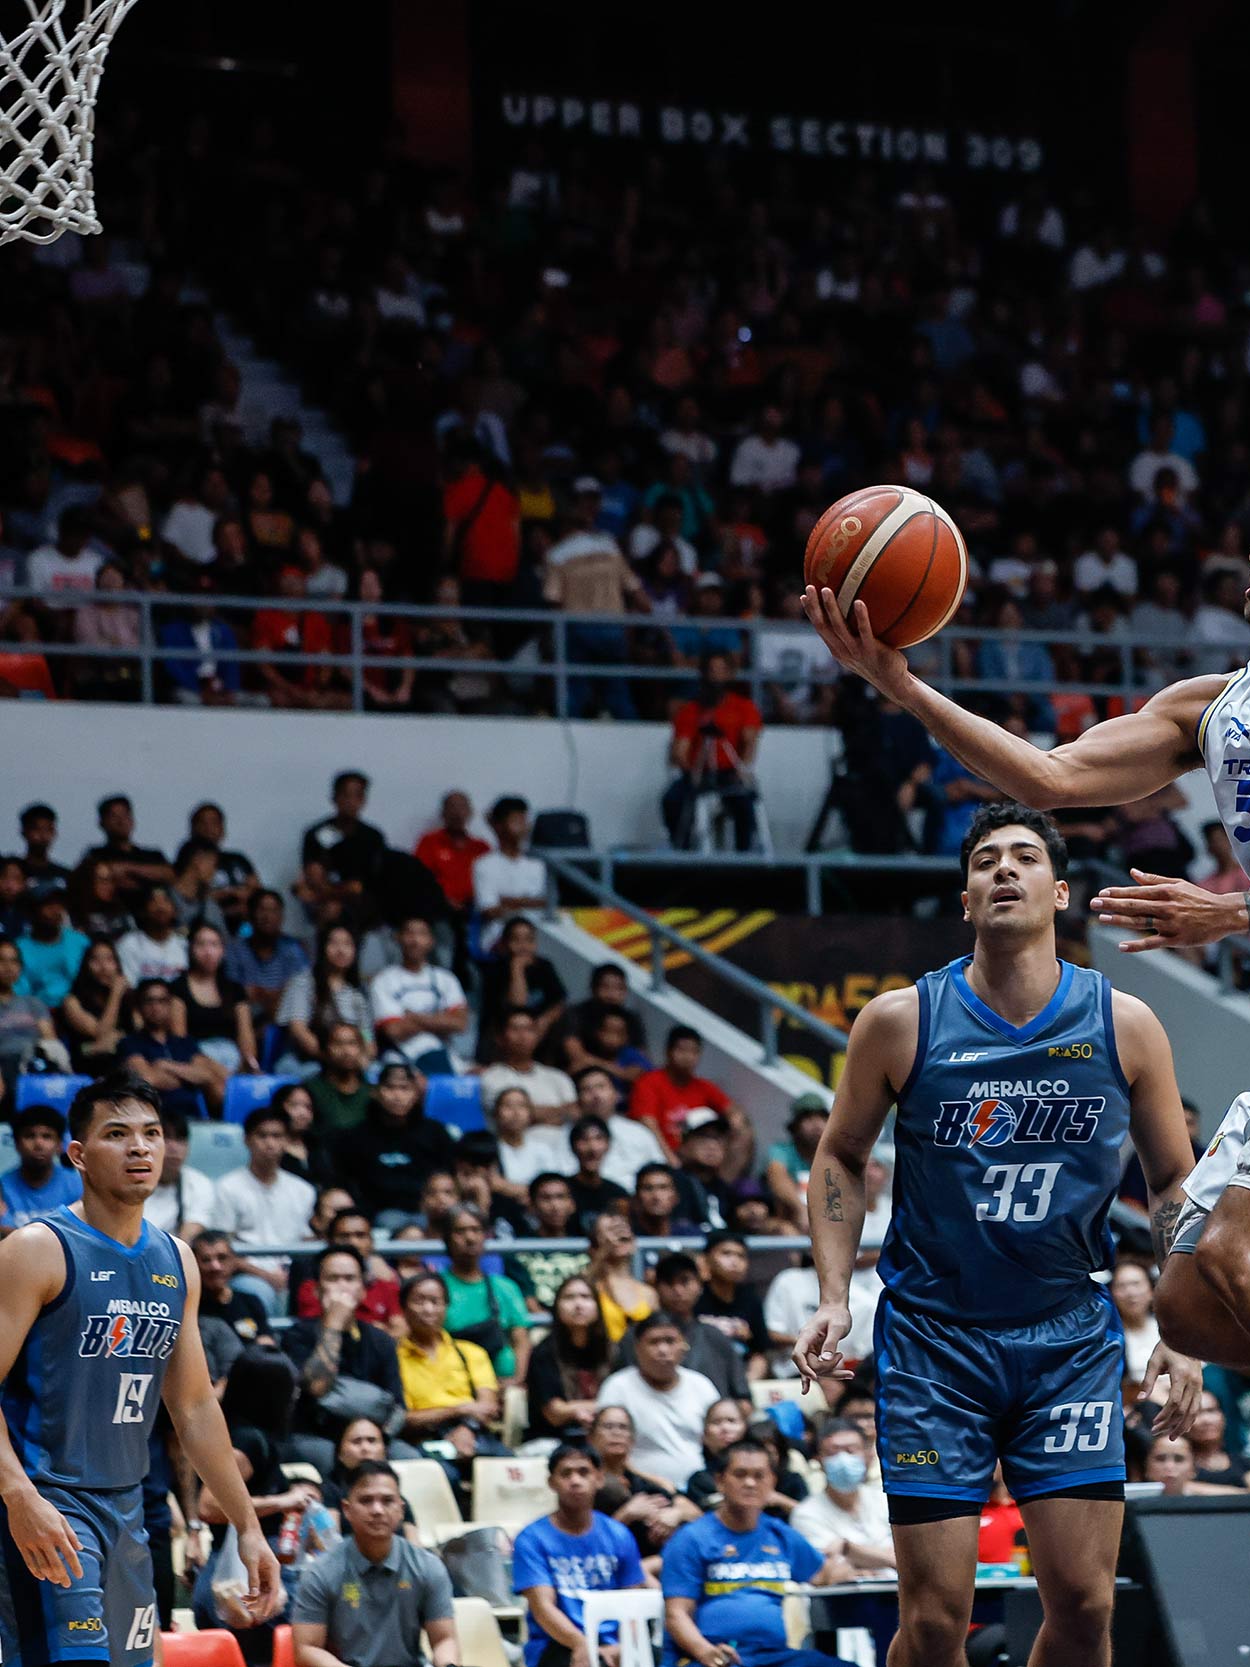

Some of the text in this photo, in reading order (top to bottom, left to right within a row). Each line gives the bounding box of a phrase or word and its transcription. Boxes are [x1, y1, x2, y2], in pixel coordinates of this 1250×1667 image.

[502, 94, 641, 137] UPPER
[660, 106, 749, 146] BOX
[770, 114, 947, 164] SECTION
[966, 1080, 1070, 1098] MERALCO
[933, 1097, 1106, 1148] BOLTS
[976, 1163, 1063, 1222] 33
[1044, 1401, 1114, 1453] 33
[125, 1603, 156, 1651] 19
